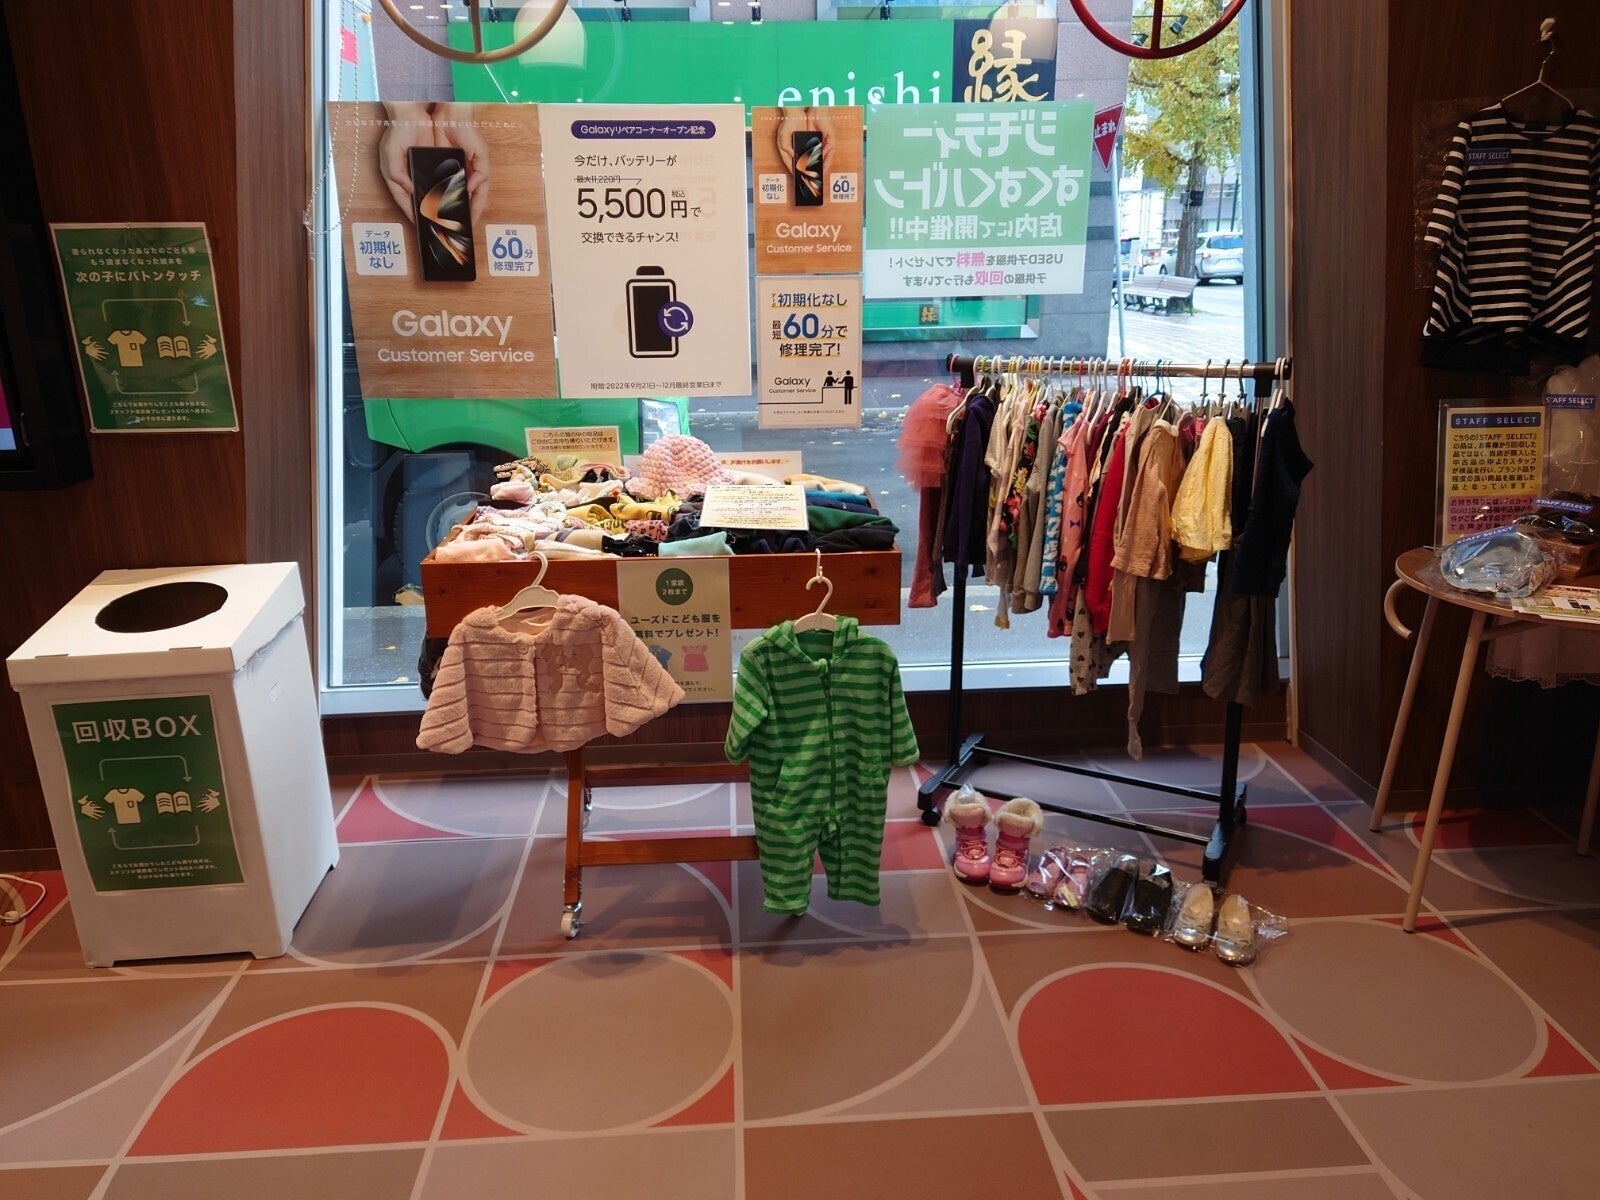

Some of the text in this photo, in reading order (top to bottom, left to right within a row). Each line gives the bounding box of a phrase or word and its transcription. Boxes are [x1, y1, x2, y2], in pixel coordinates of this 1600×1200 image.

[777, 70, 941, 105] enishi
[581, 125, 705, 136] Galaxyリペアコーナーオープン記念
[1094, 119, 1117, 138] 止まれ
[574, 154, 677, 167] 今だけ、バッテリーが
[1468, 152, 1487, 160] STAFF
[762, 184, 784, 192] 初期化
[365, 230, 390, 238] データ
[776, 222, 841, 242] Galaxy
[359, 241, 400, 255] 初期化
[766, 243, 852, 253] Customer Service
[369, 256, 393, 269] なし
[494, 261, 534, 272] 修理完了
[75, 270, 201, 283] 次の子にバトンタッチ
[392, 310, 513, 345] Galaxy
[377, 347, 534, 362] Customer Service
[774, 377, 810, 387] Galaxy
[1455, 416, 1537, 425] STAFF SELECT
[1452, 483, 1534, 491] 品となっています。
[1561, 502, 1591, 510] SELECT
[1456, 526, 1512, 544] STAFF SELECT
[631, 614, 720, 624] ユーズドこども服を
[72, 715, 202, 743] 回収BOX
